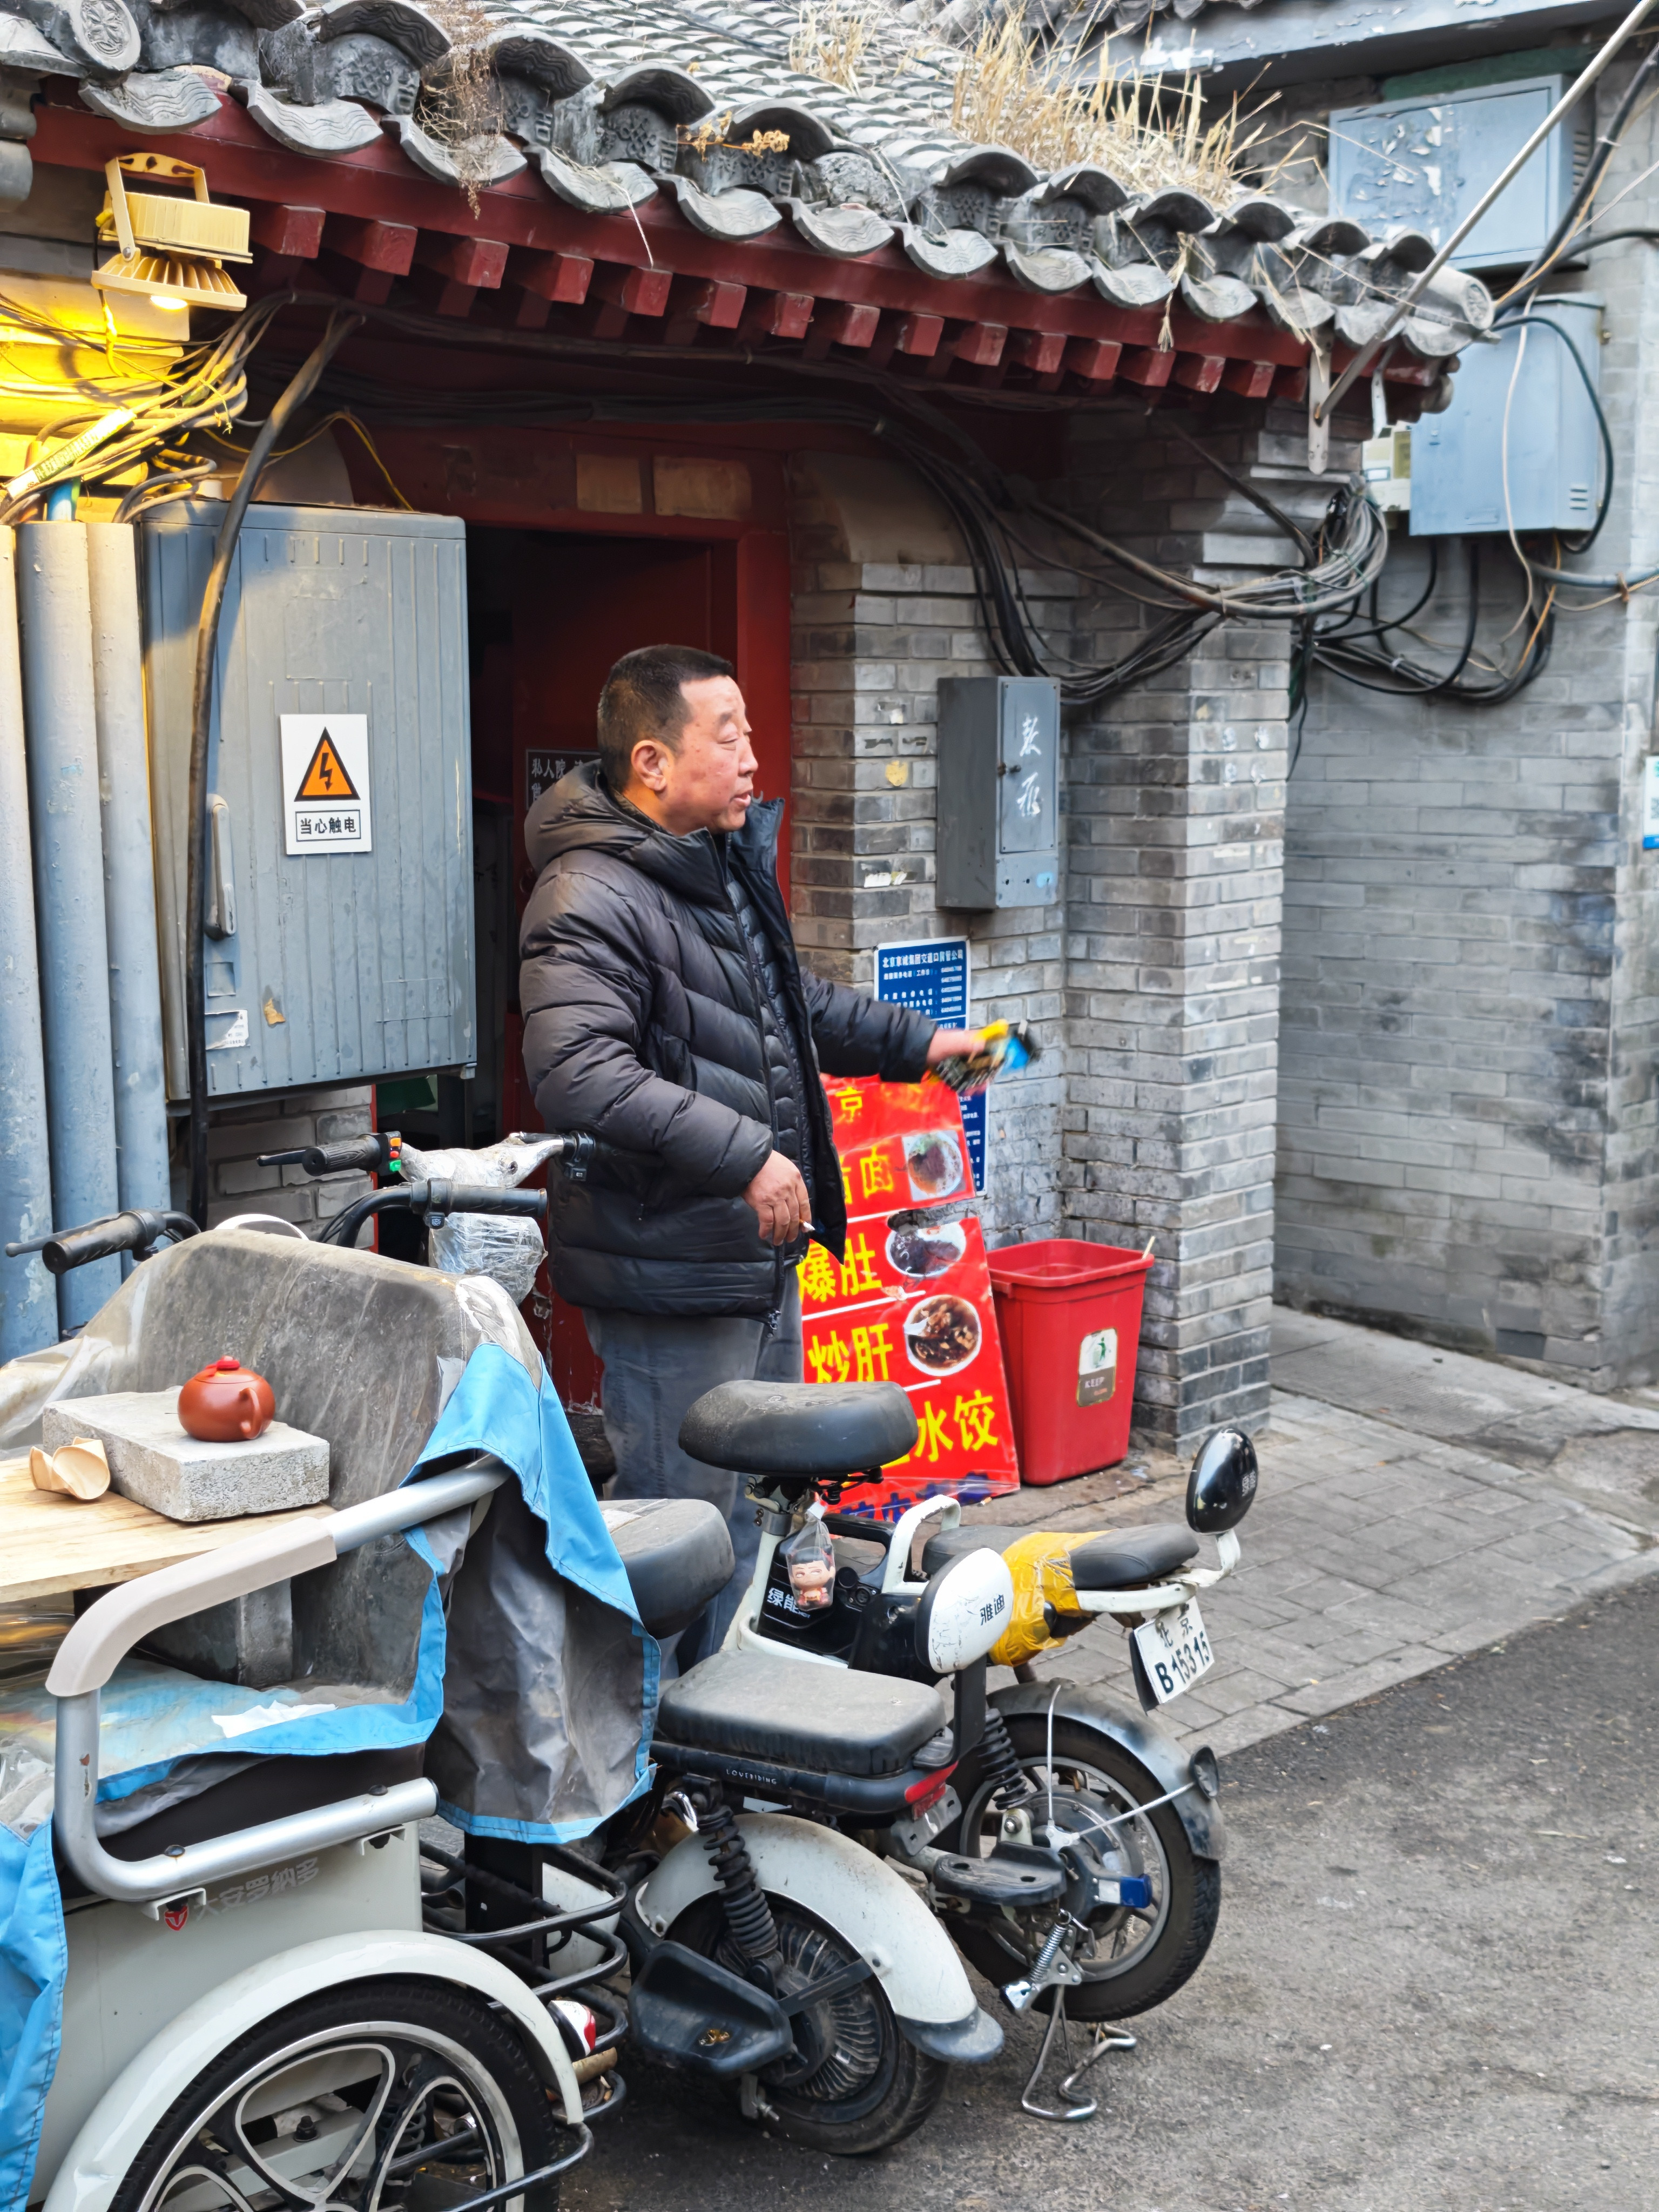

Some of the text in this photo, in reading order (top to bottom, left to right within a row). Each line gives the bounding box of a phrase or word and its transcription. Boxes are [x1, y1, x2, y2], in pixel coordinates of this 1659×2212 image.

[300, 816, 356, 835] 当心触电
[835, 1085, 865, 1123] 京
[797, 1233, 882, 1303] 爆肚
[808, 1323, 893, 1383] 炒肝
[881, 1390, 999, 1469] 水饺
[767, 1587, 811, 1618] 绿能
[980, 1594, 1005, 1626] 雅迪
